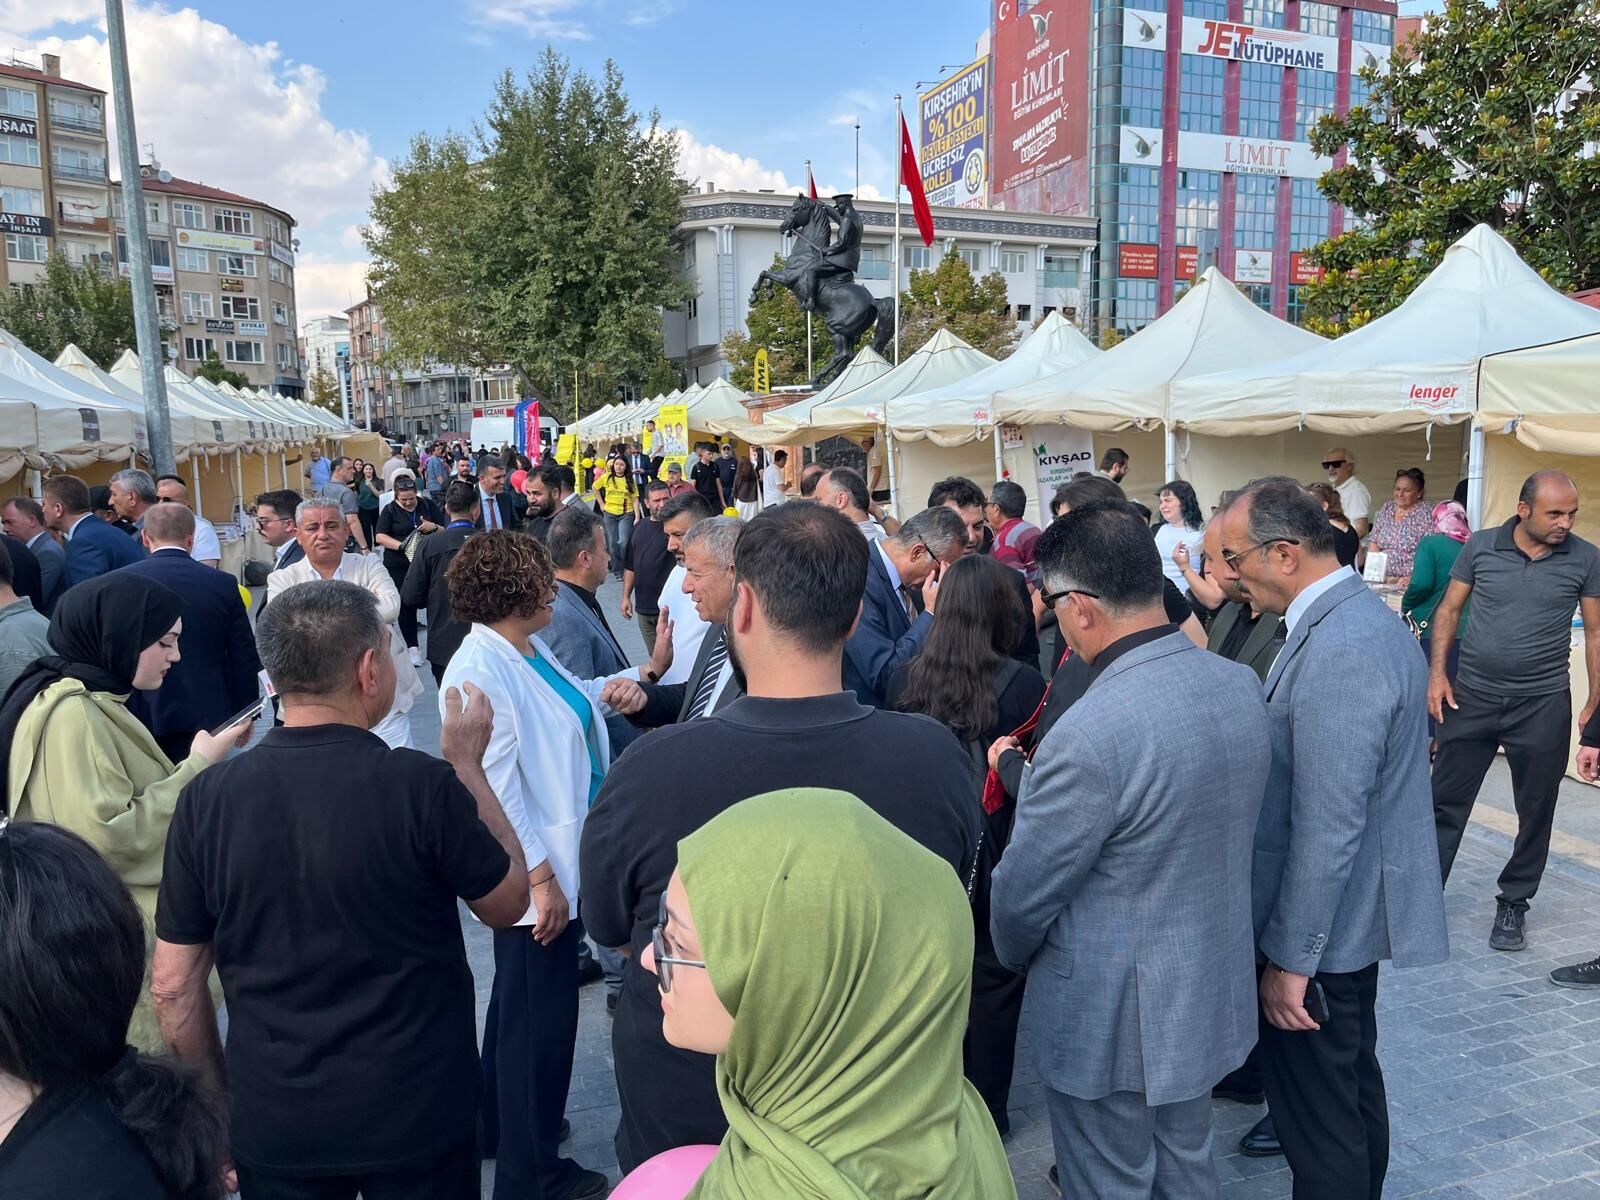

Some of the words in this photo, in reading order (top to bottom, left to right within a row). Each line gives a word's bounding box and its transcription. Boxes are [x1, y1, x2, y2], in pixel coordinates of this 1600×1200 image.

[1197, 21, 1254, 56] JET
[1233, 38, 1324, 69] KÜTÜPHANE
[1011, 49, 1070, 110] LİMİT
[0, 118, 35, 135] ŞAAT
[929, 96, 976, 141] %100
[923, 136, 949, 161] DEVLET
[923, 144, 965, 177] ÜCRETSİZ
[1224, 138, 1291, 167] LİMİT
[0, 213, 41, 227] AYDIN
[11, 223, 42, 235] İNŞAAT
[757, 358, 766, 391] IME
[1409, 384, 1459, 402] lenger
[486, 408, 505, 416] CZANE
[1039, 451, 1092, 466] KIYŞAD
